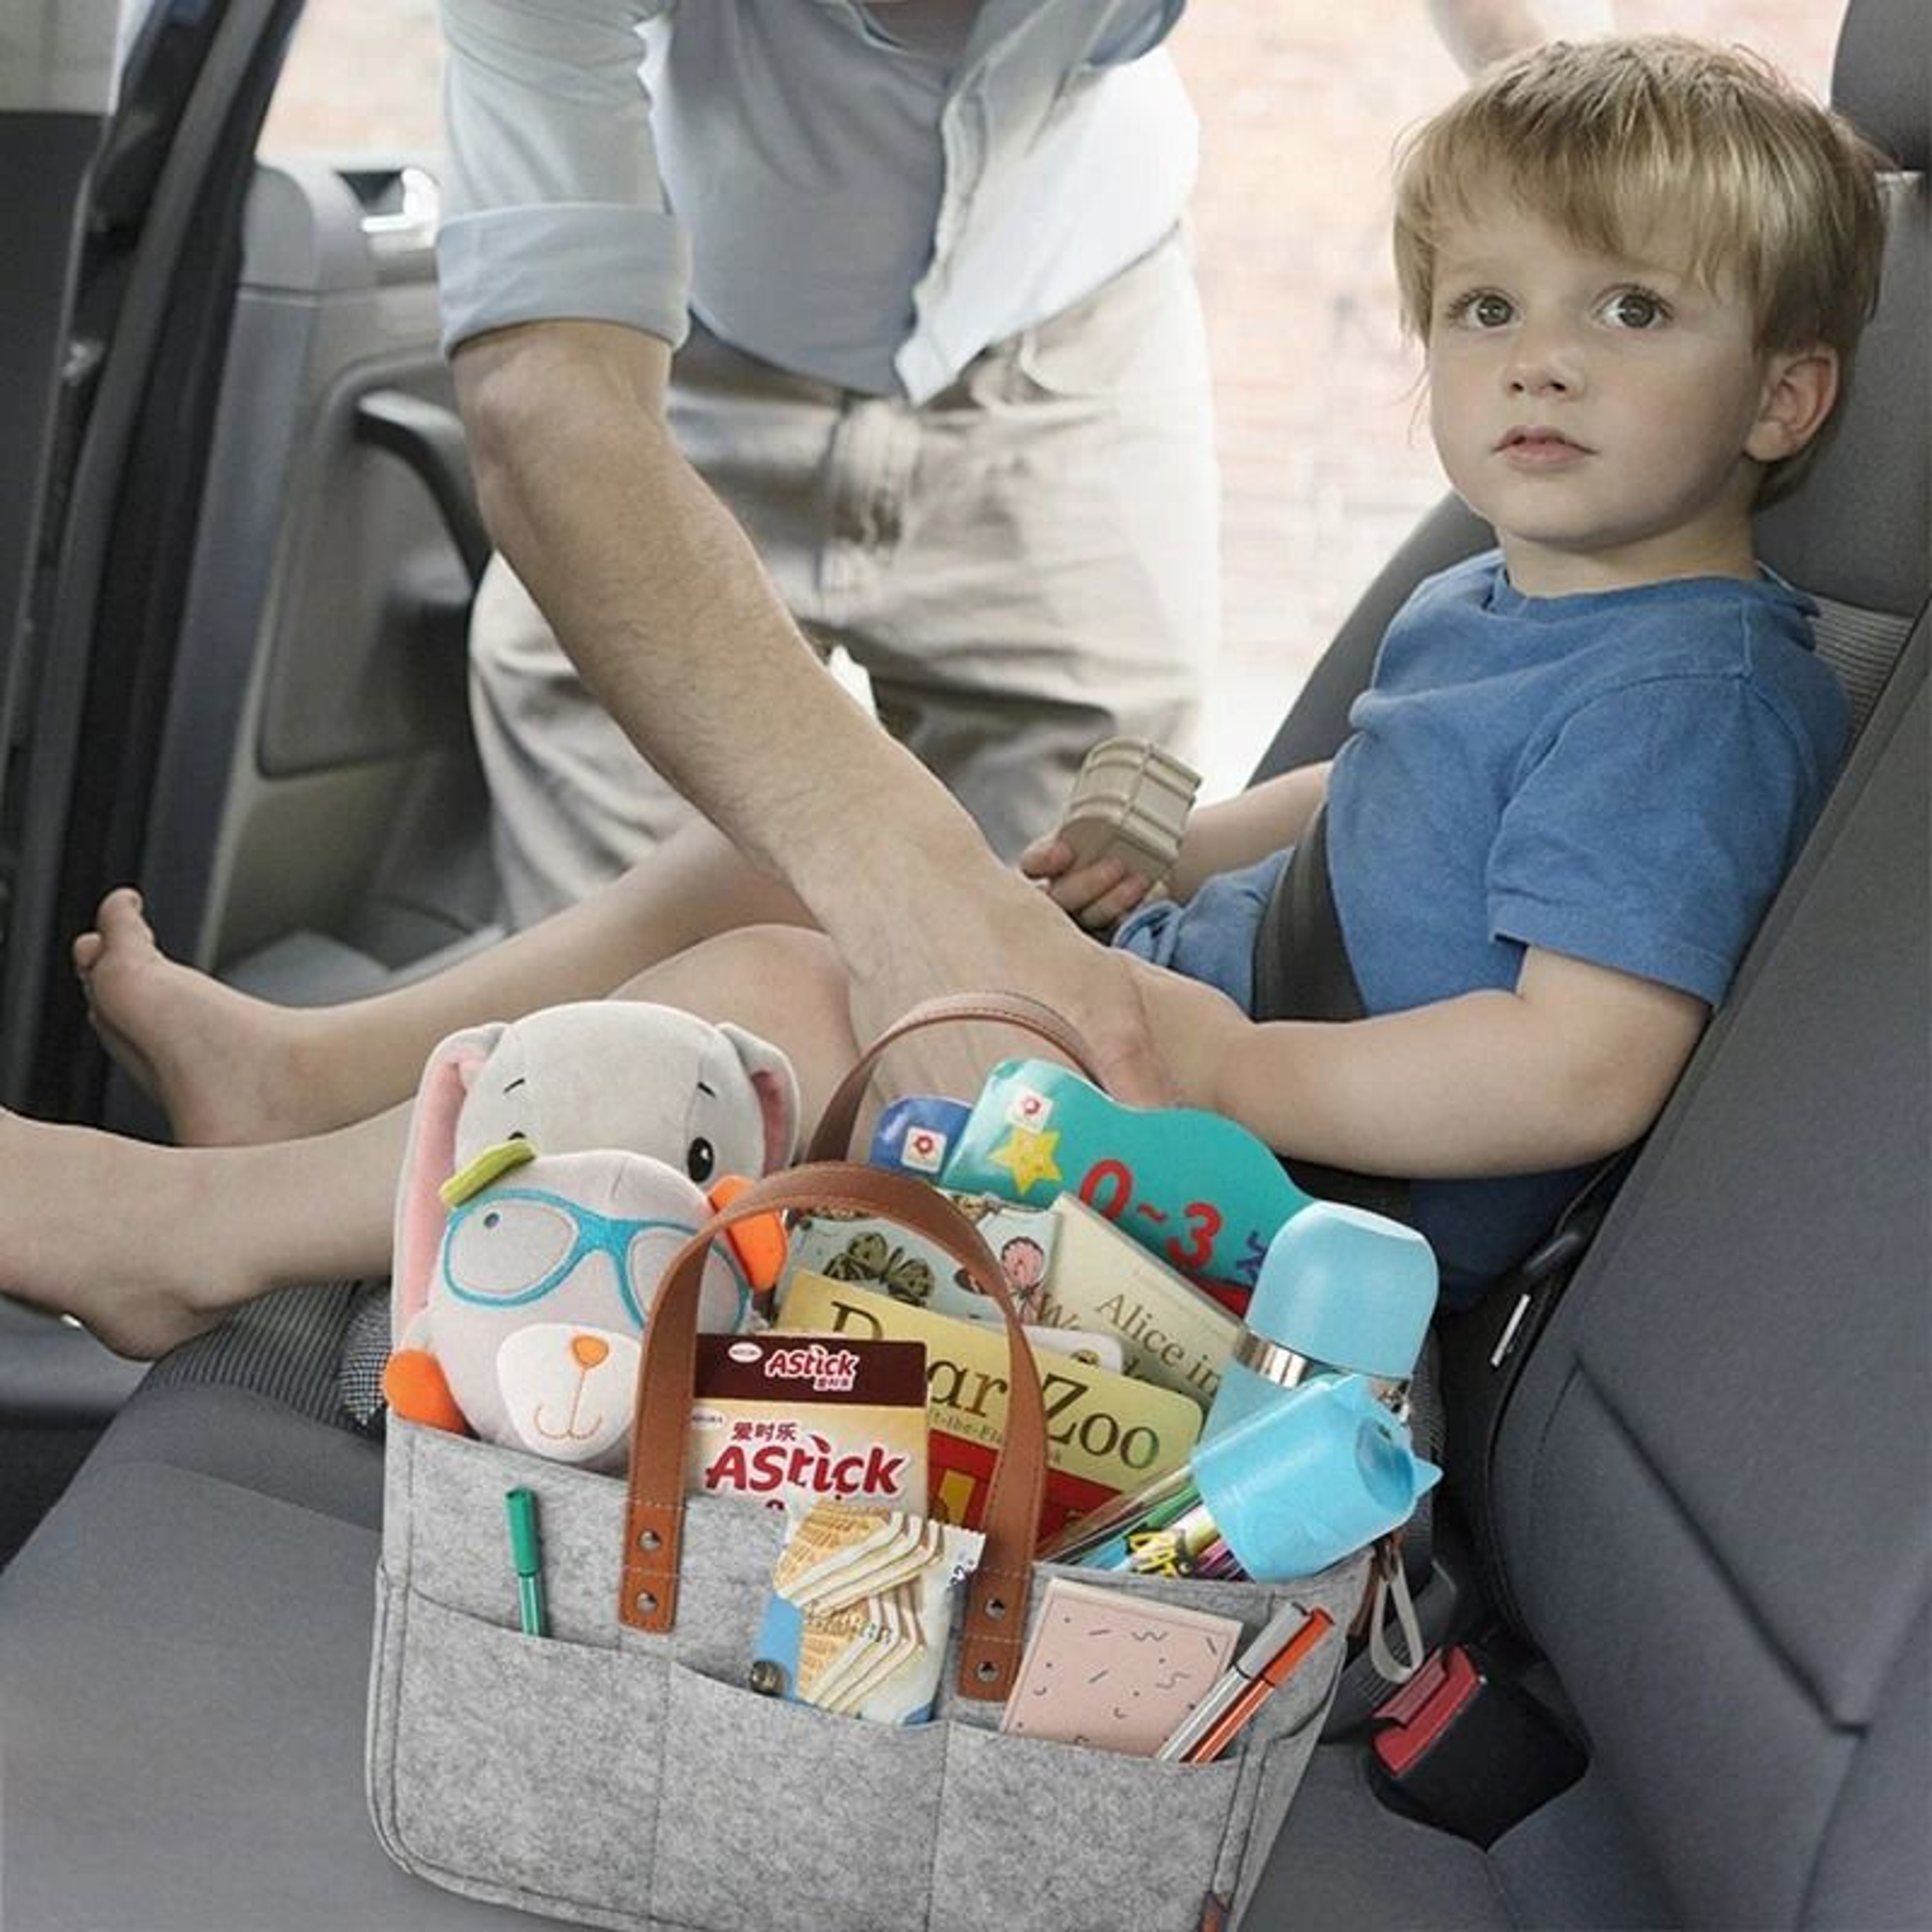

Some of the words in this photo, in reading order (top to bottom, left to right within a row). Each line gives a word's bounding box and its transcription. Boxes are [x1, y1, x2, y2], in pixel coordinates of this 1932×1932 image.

[768, 1344, 857, 1376] AStick
[1093, 1294, 1185, 1367] Alice
[731, 1421, 797, 1441] 爱时乐
[1042, 1372, 1160, 1470] Zoo
[705, 1434, 904, 1495] AStick
